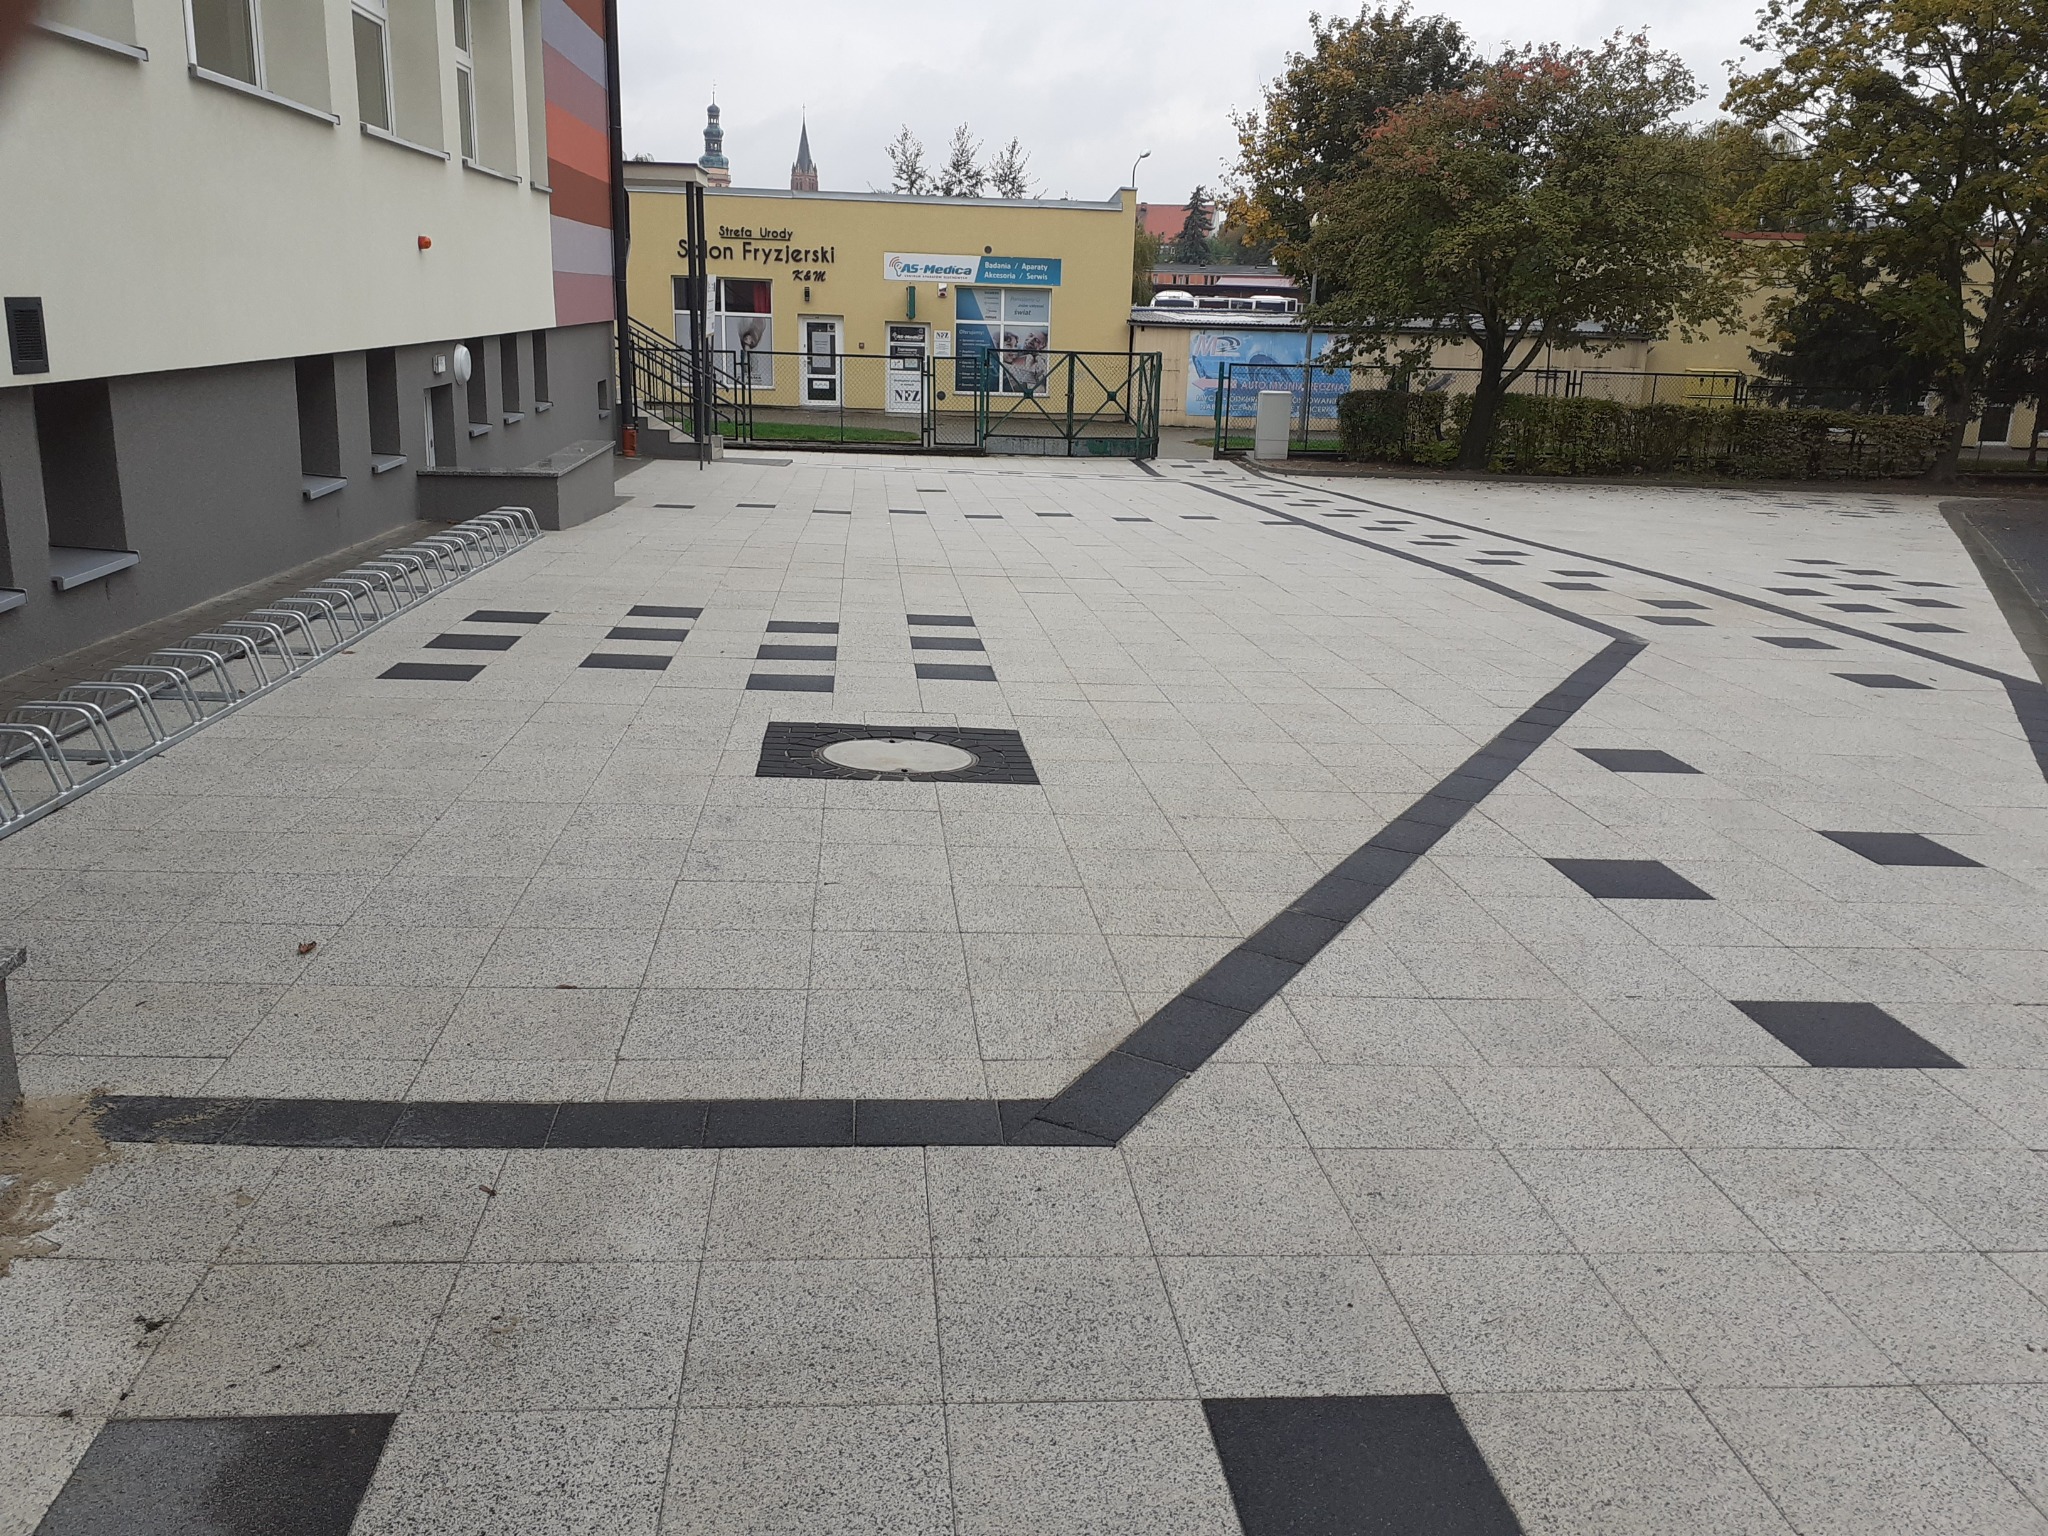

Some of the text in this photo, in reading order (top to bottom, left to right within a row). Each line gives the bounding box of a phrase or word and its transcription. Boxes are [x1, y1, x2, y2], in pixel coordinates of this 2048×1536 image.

[719, 225, 793, 241] Strefa Urody
[677, 239, 835, 265] Slon Fryzjerski
[900, 263, 972, 276] AS-Medica
[984, 261, 1011, 270] Badania
[1021, 263, 1048, 272] Aparaty
[791, 269, 827, 282] K&M
[984, 271, 1016, 280] Akcesoria
[1026, 272, 1048, 281] Serwis
[936, 331, 950, 339] NFZ
[1240, 380, 1267, 390] AUTO
[894, 389, 920, 402] NFZ
